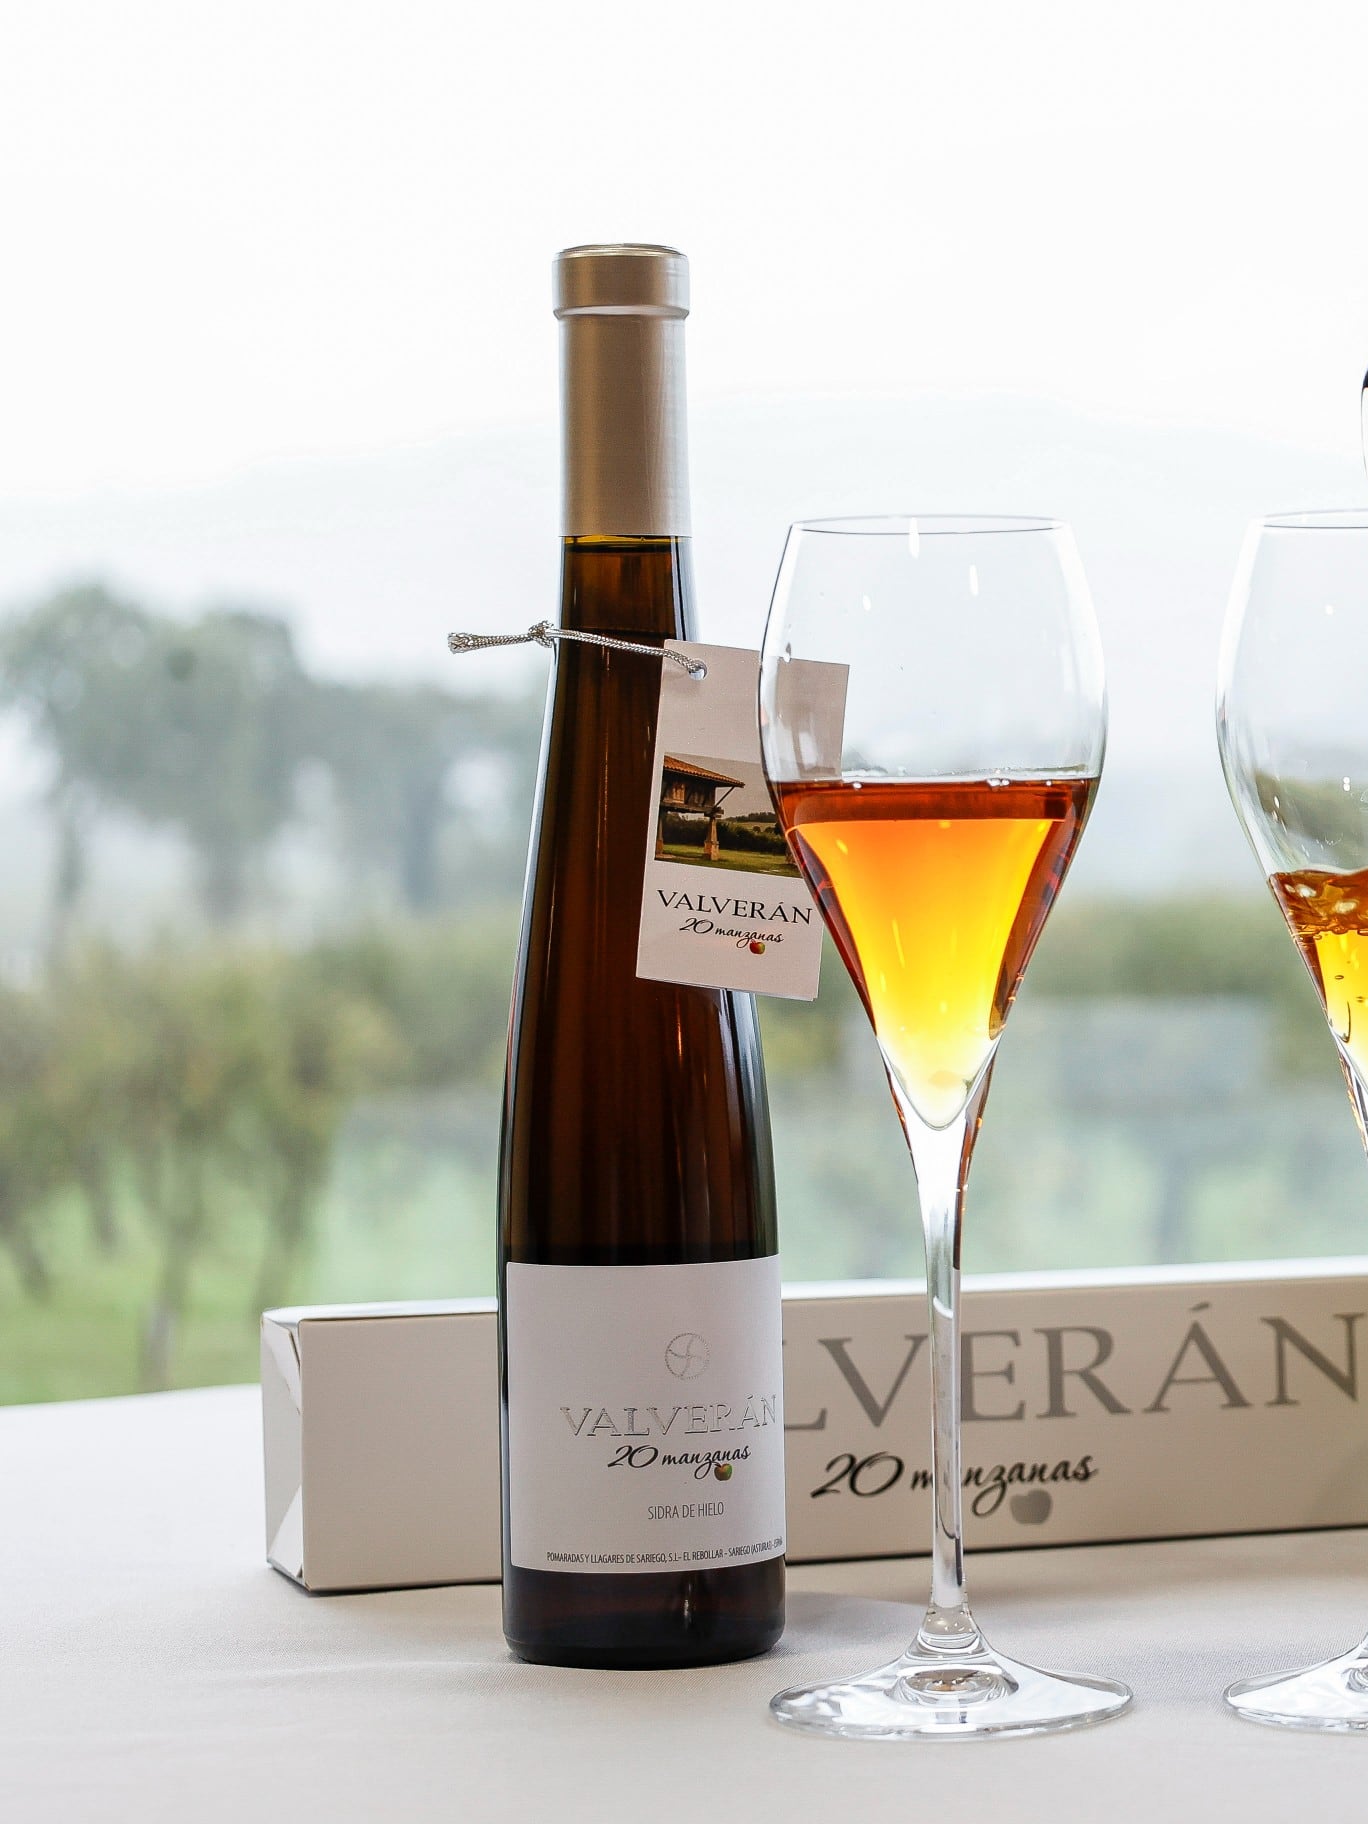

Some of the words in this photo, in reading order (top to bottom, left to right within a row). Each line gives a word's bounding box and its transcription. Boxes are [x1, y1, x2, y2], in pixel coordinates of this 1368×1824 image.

[657, 889, 813, 925] VALVERÁN
[679, 917, 714, 934] 20
[715, 926, 785, 949] manzanas
[559, 1394, 777, 1437] VALVERÁN
[607, 1444, 659, 1469] 20
[661, 1445, 752, 1480] manzanas
[810, 1450, 905, 1499] 20
[910, 1454, 1099, 1519] mnzanas
[648, 1504, 680, 1521] SIDRA
[682, 1503, 696, 1519] DE
[698, 1501, 725, 1518] HIELO
[546, 1551, 584, 1564] POMARADAS
[584, 1553, 590, 1564] Y
[590, 1553, 625, 1564] LLAGARES
[625, 1554, 636, 1564] DE
[683, 1551, 691, 1561] EL
[692, 1548, 724, 1561] REBOLLAR
